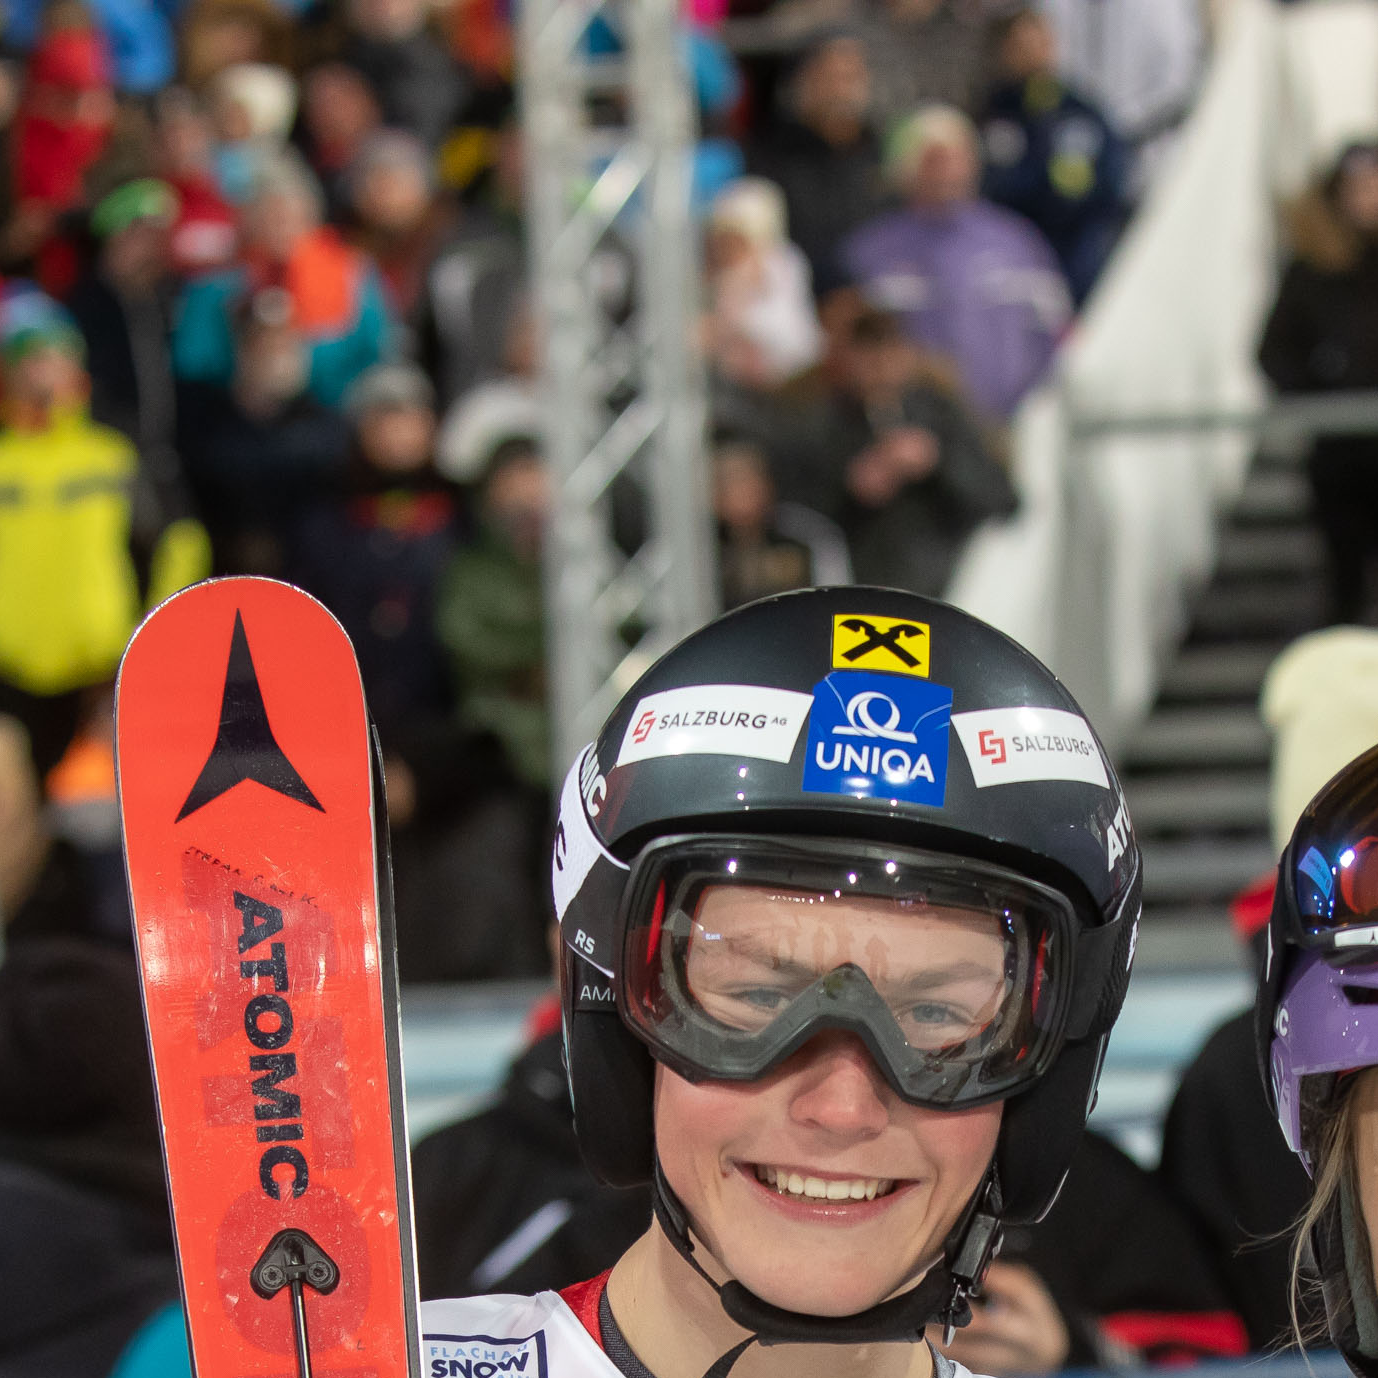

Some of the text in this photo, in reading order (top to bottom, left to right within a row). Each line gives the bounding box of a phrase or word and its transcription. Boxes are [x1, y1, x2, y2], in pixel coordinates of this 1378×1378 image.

[659, 711, 767, 730] SALZBURG
[1012, 736, 1090, 756] SALZBURG
[816, 741, 935, 783] UNIQA
[575, 929, 596, 955] RS
[579, 985, 615, 1003] AM
[233, 890, 309, 1201] ATOMIC
[430, 1344, 527, 1361] FLACHAU
[431, 1352, 529, 1378] SNOW
